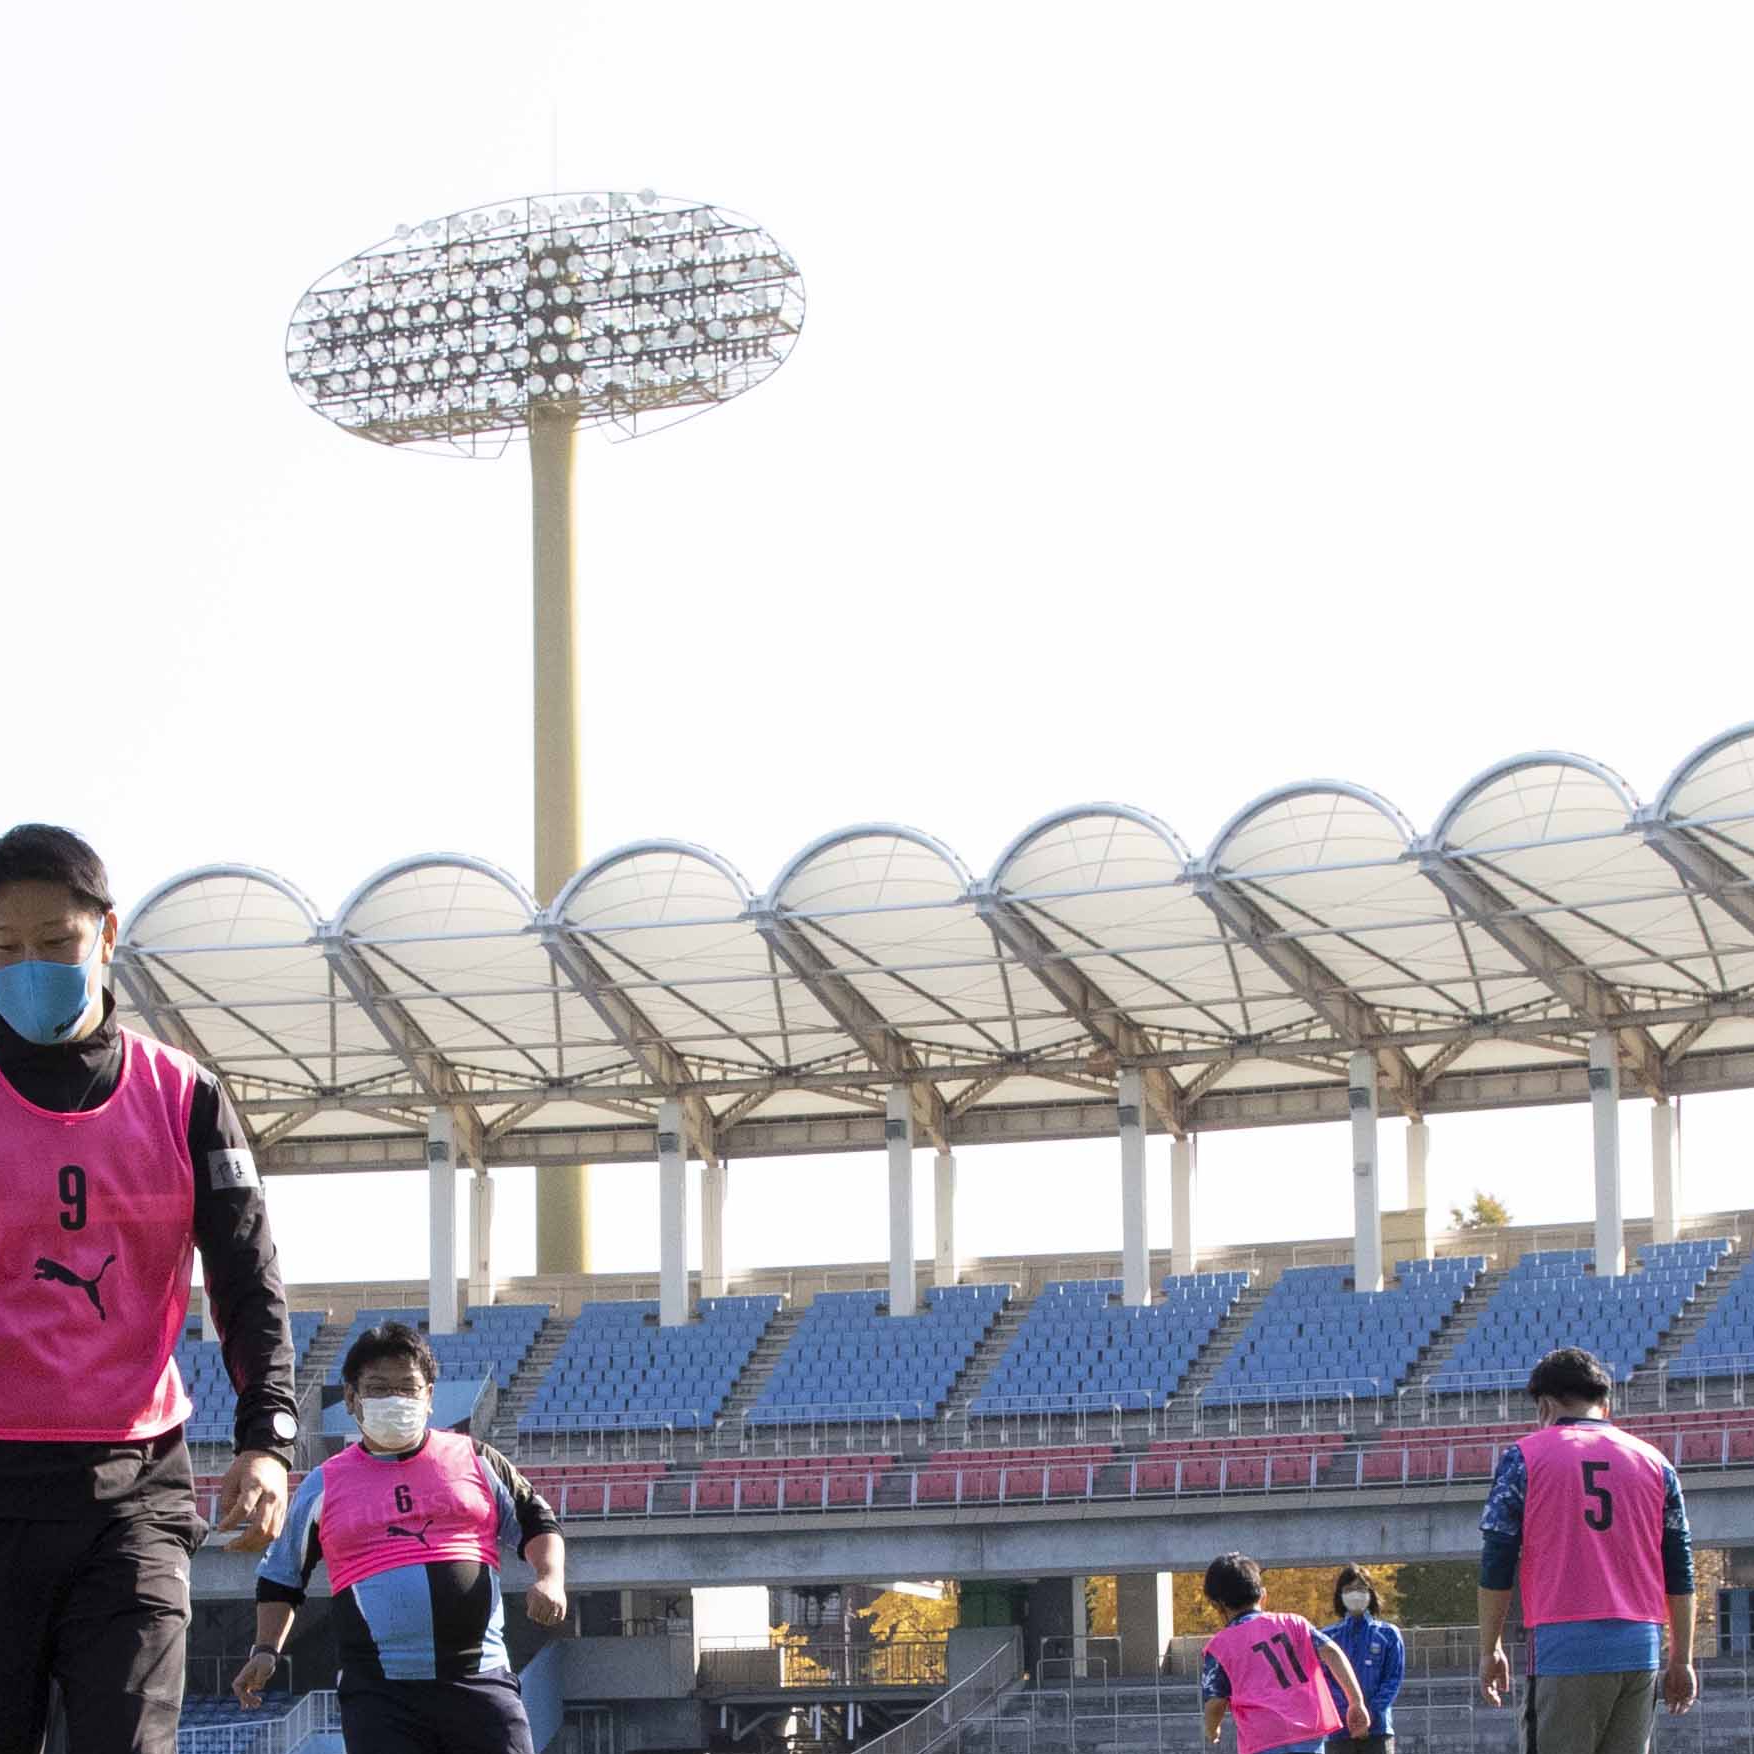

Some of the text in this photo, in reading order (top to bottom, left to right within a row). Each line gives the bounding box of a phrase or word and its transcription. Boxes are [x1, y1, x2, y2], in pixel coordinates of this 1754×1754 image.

[59, 1165, 86, 1231] 9
[394, 1485, 413, 1513] 6
[1581, 1461, 1612, 1531] 5
[1252, 1632, 1309, 1689] 11
